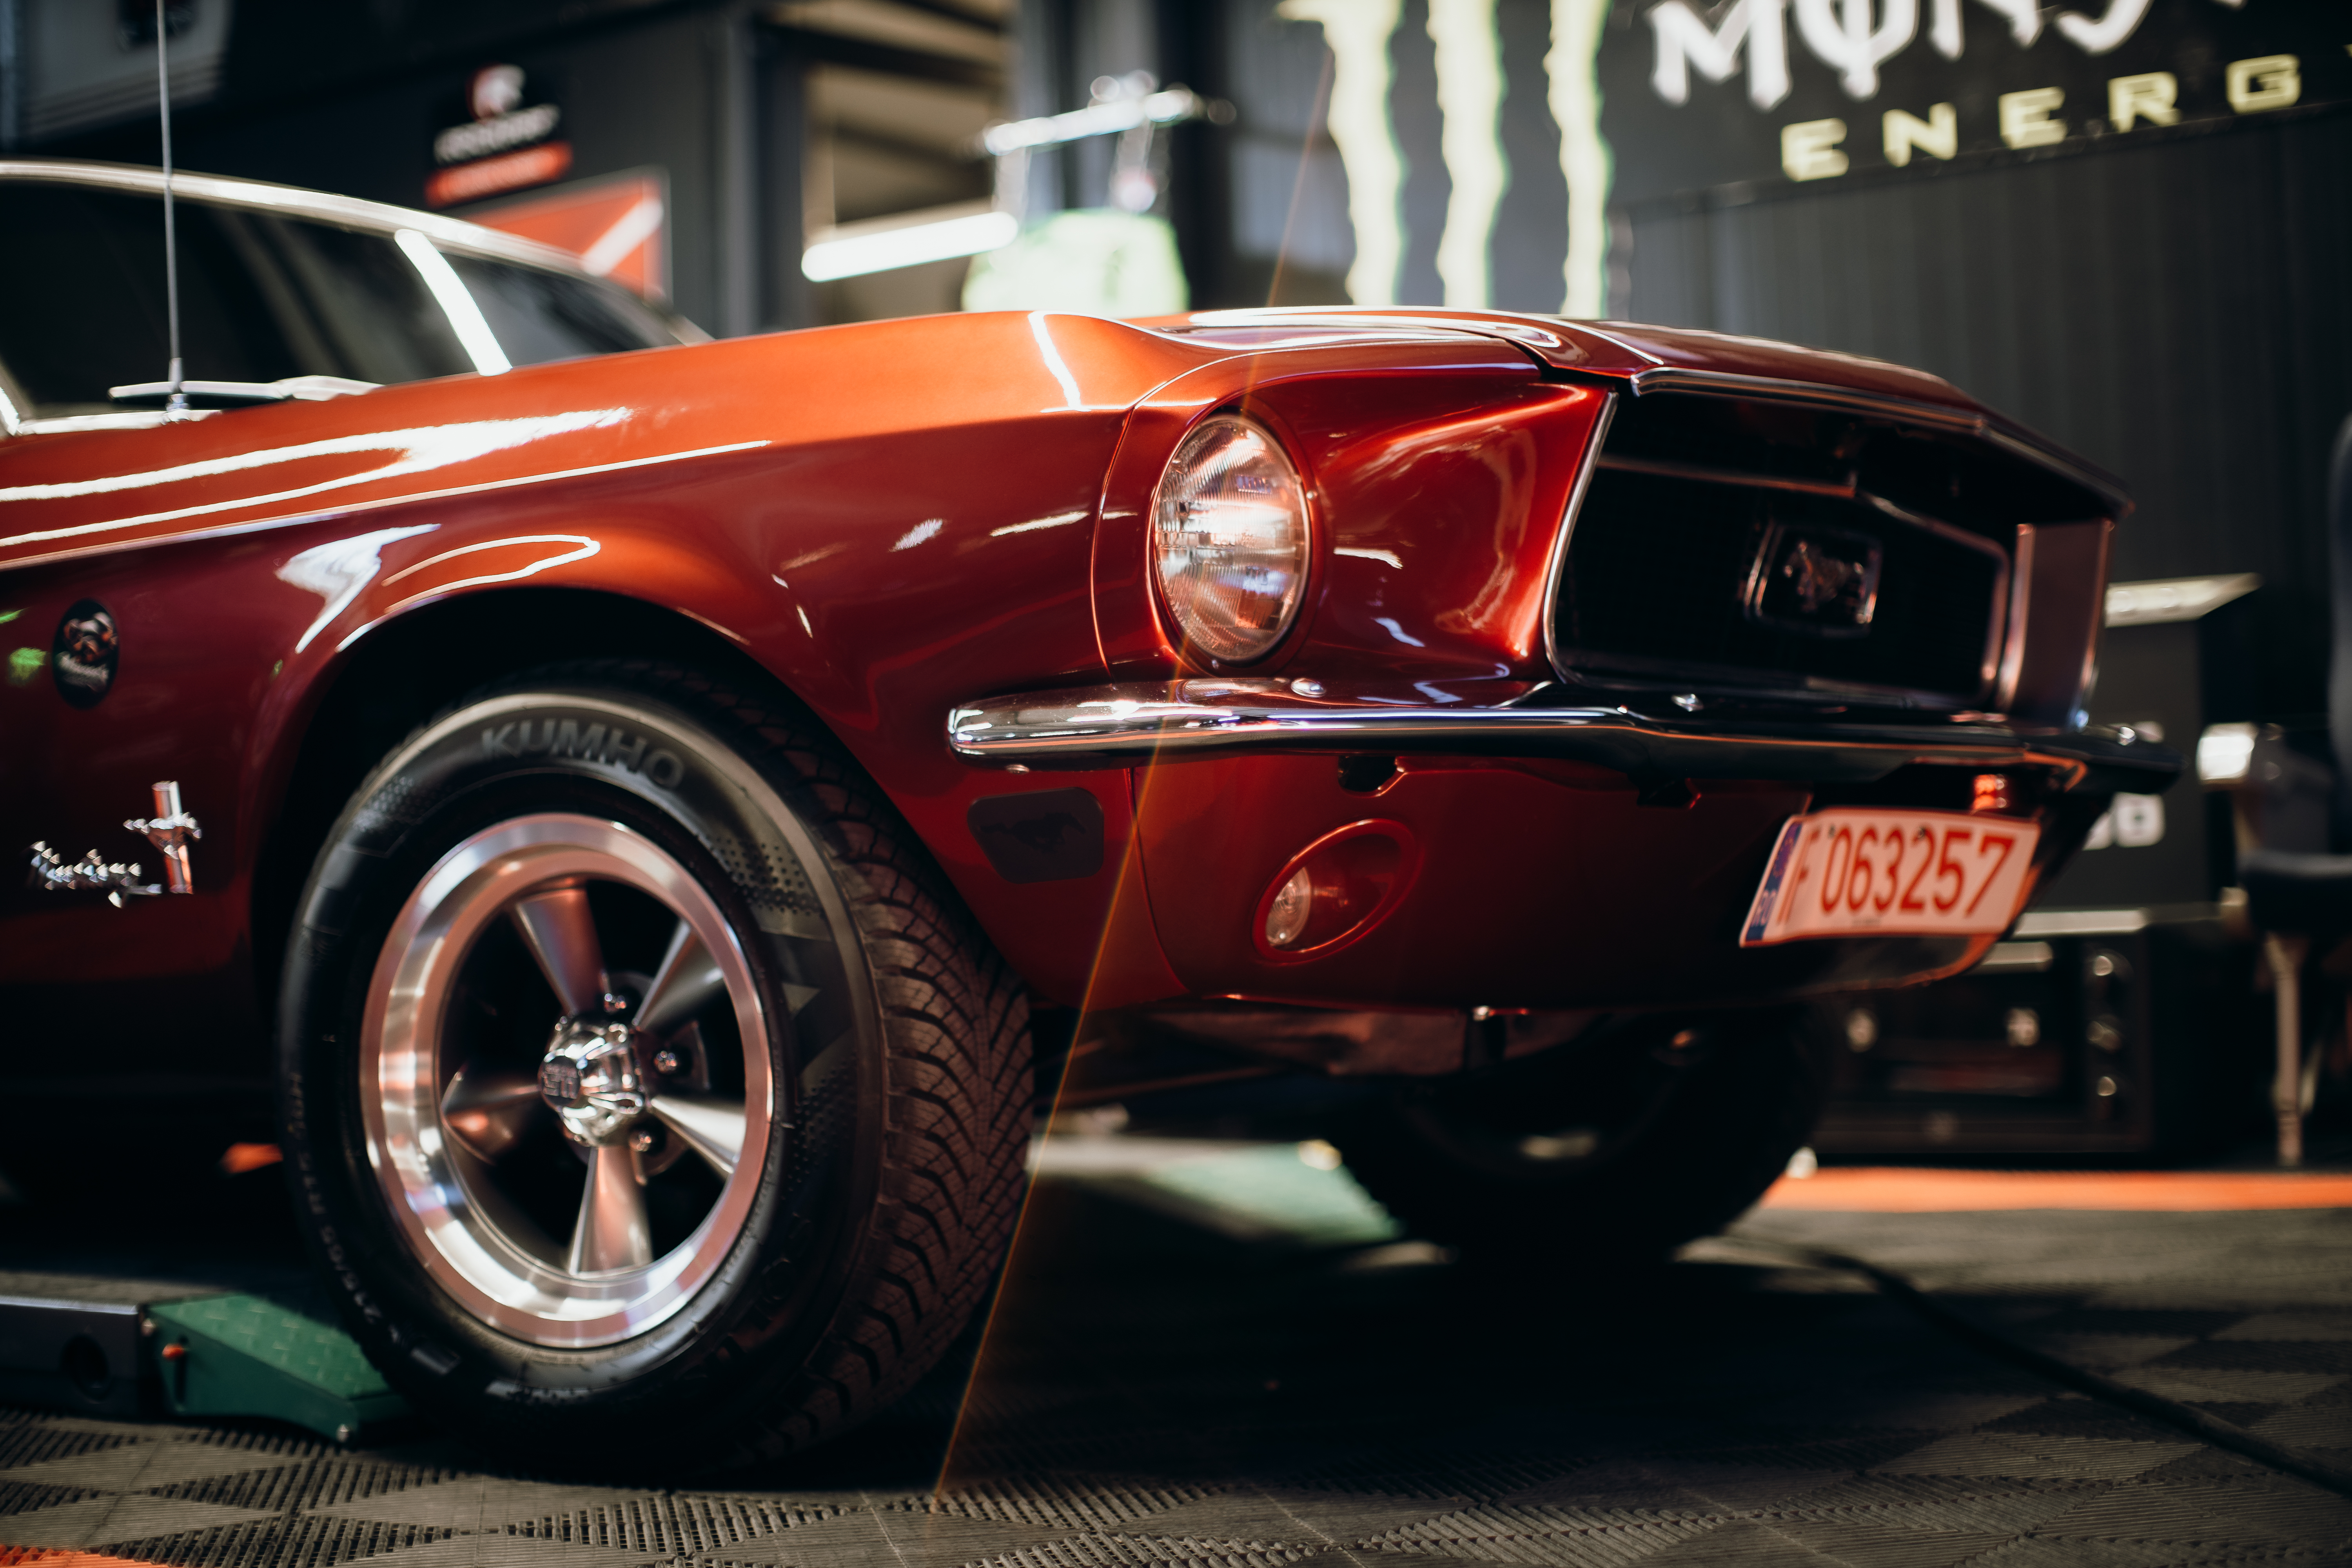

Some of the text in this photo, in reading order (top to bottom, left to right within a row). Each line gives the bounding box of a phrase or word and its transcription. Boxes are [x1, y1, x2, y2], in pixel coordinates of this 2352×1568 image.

[1780, 44, 2352, 182] ENERG
[482, 718, 684, 791] KUMHO
[1820, 822, 2017, 921] 063257
